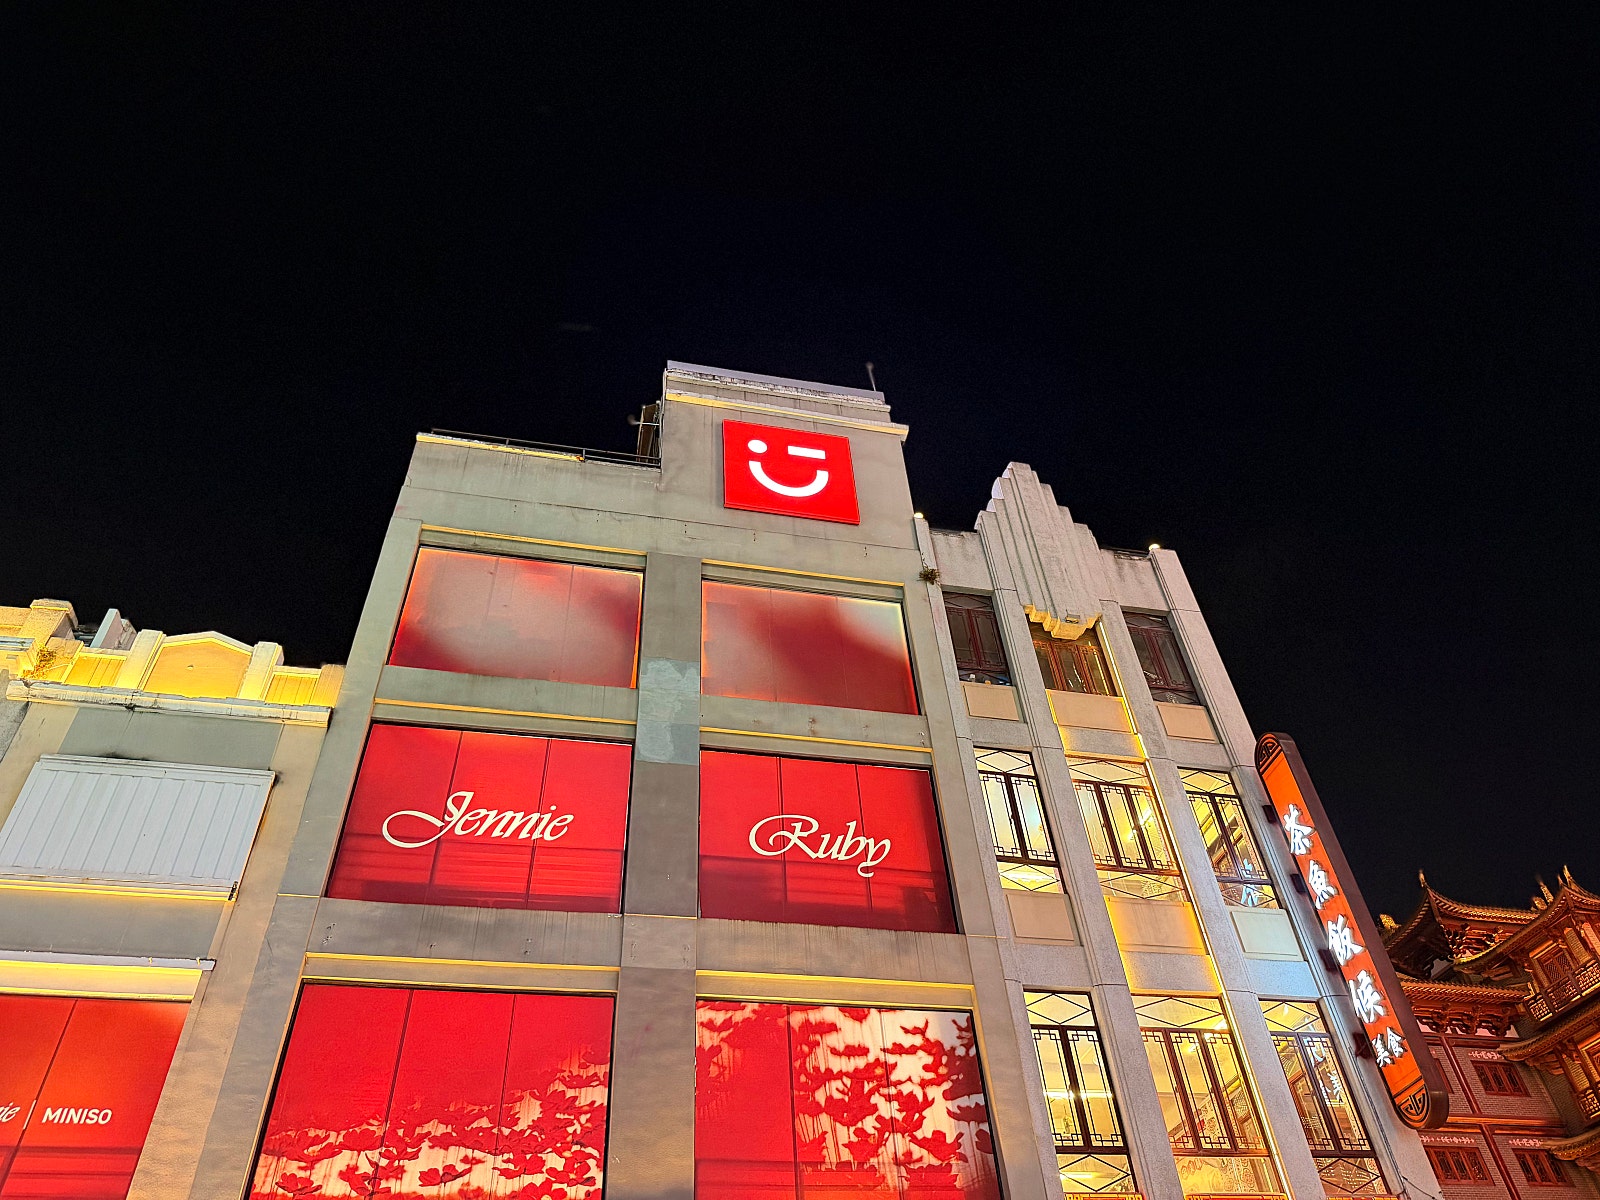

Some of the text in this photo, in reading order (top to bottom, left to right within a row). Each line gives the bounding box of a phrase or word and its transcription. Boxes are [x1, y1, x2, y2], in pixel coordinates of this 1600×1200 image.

[382, 791, 574, 848] Jennie
[749, 814, 891, 878] Ruby
[1371, 1027, 1404, 1068] 美食
[42, 1107, 112, 1124] MINISO
